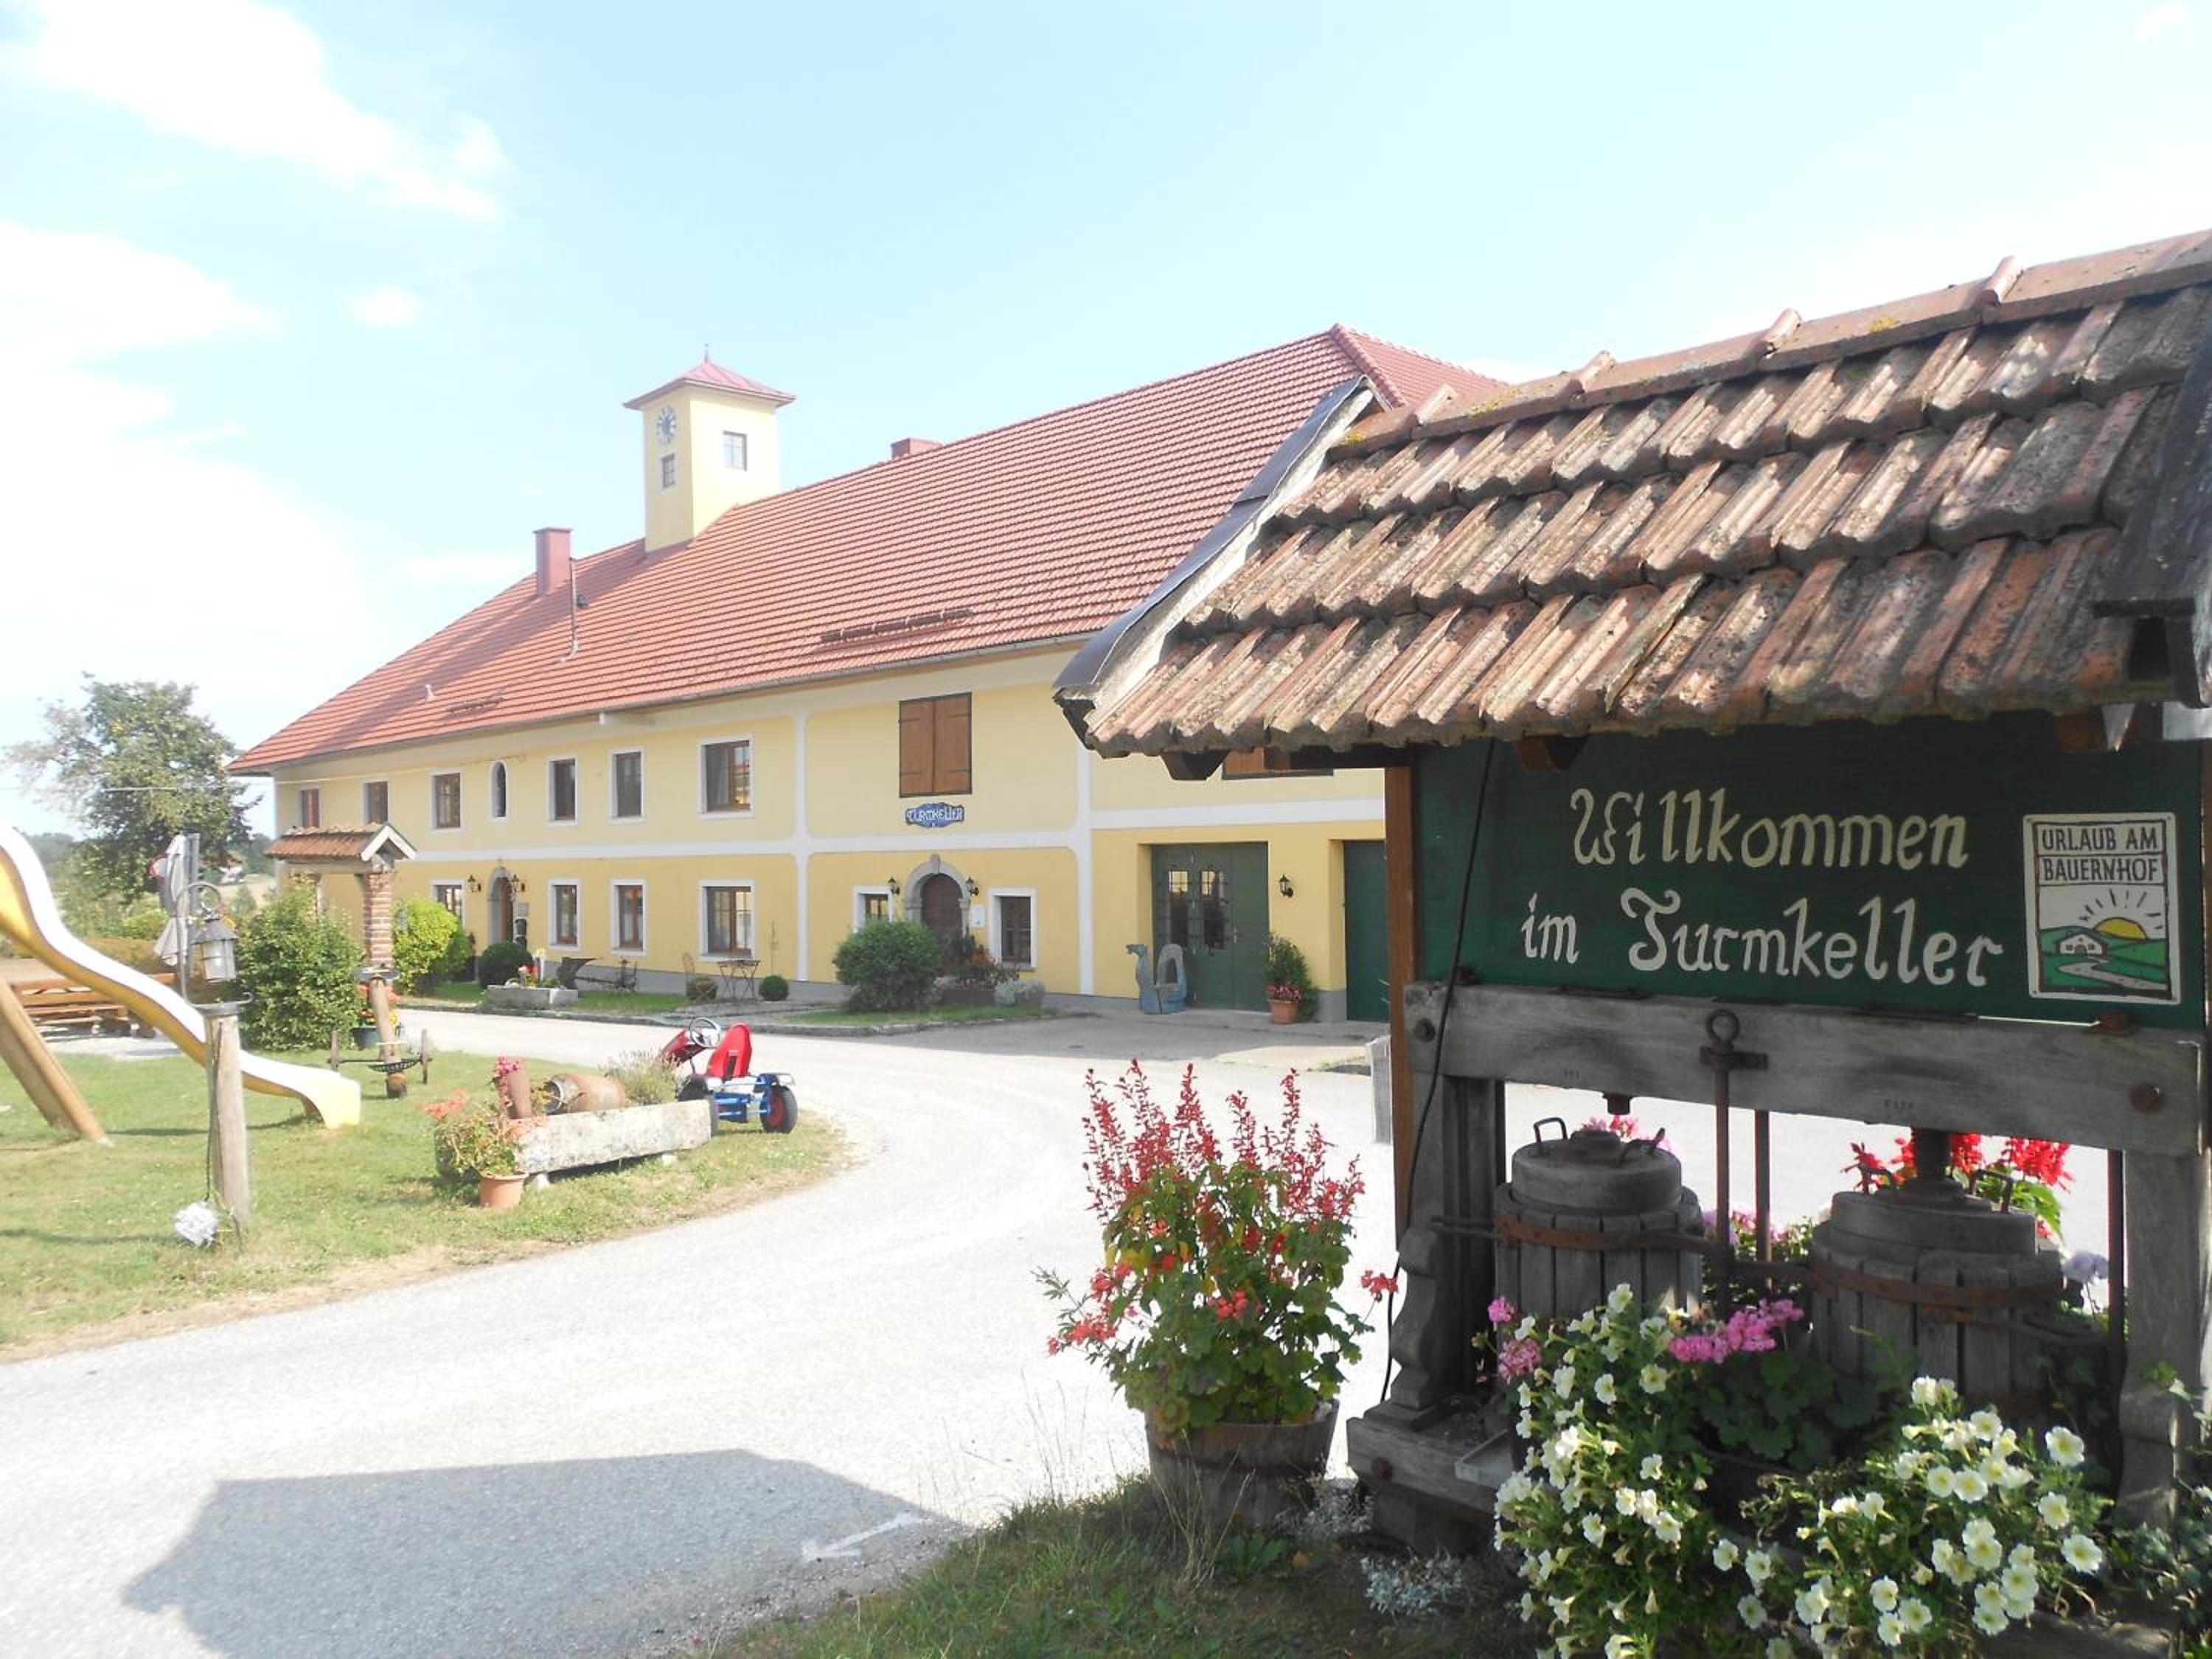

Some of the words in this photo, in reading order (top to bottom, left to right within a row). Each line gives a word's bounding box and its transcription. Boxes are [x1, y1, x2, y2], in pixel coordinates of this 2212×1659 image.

[1571, 787, 1968, 869] Willkommen
[2042, 827, 2117, 850] URLAUB
[2126, 827, 2157, 849] AM
[2044, 858, 2158, 881] BAUERNHOF
[1520, 892, 1579, 964] im
[1620, 887, 2003, 987] Turmkeller
